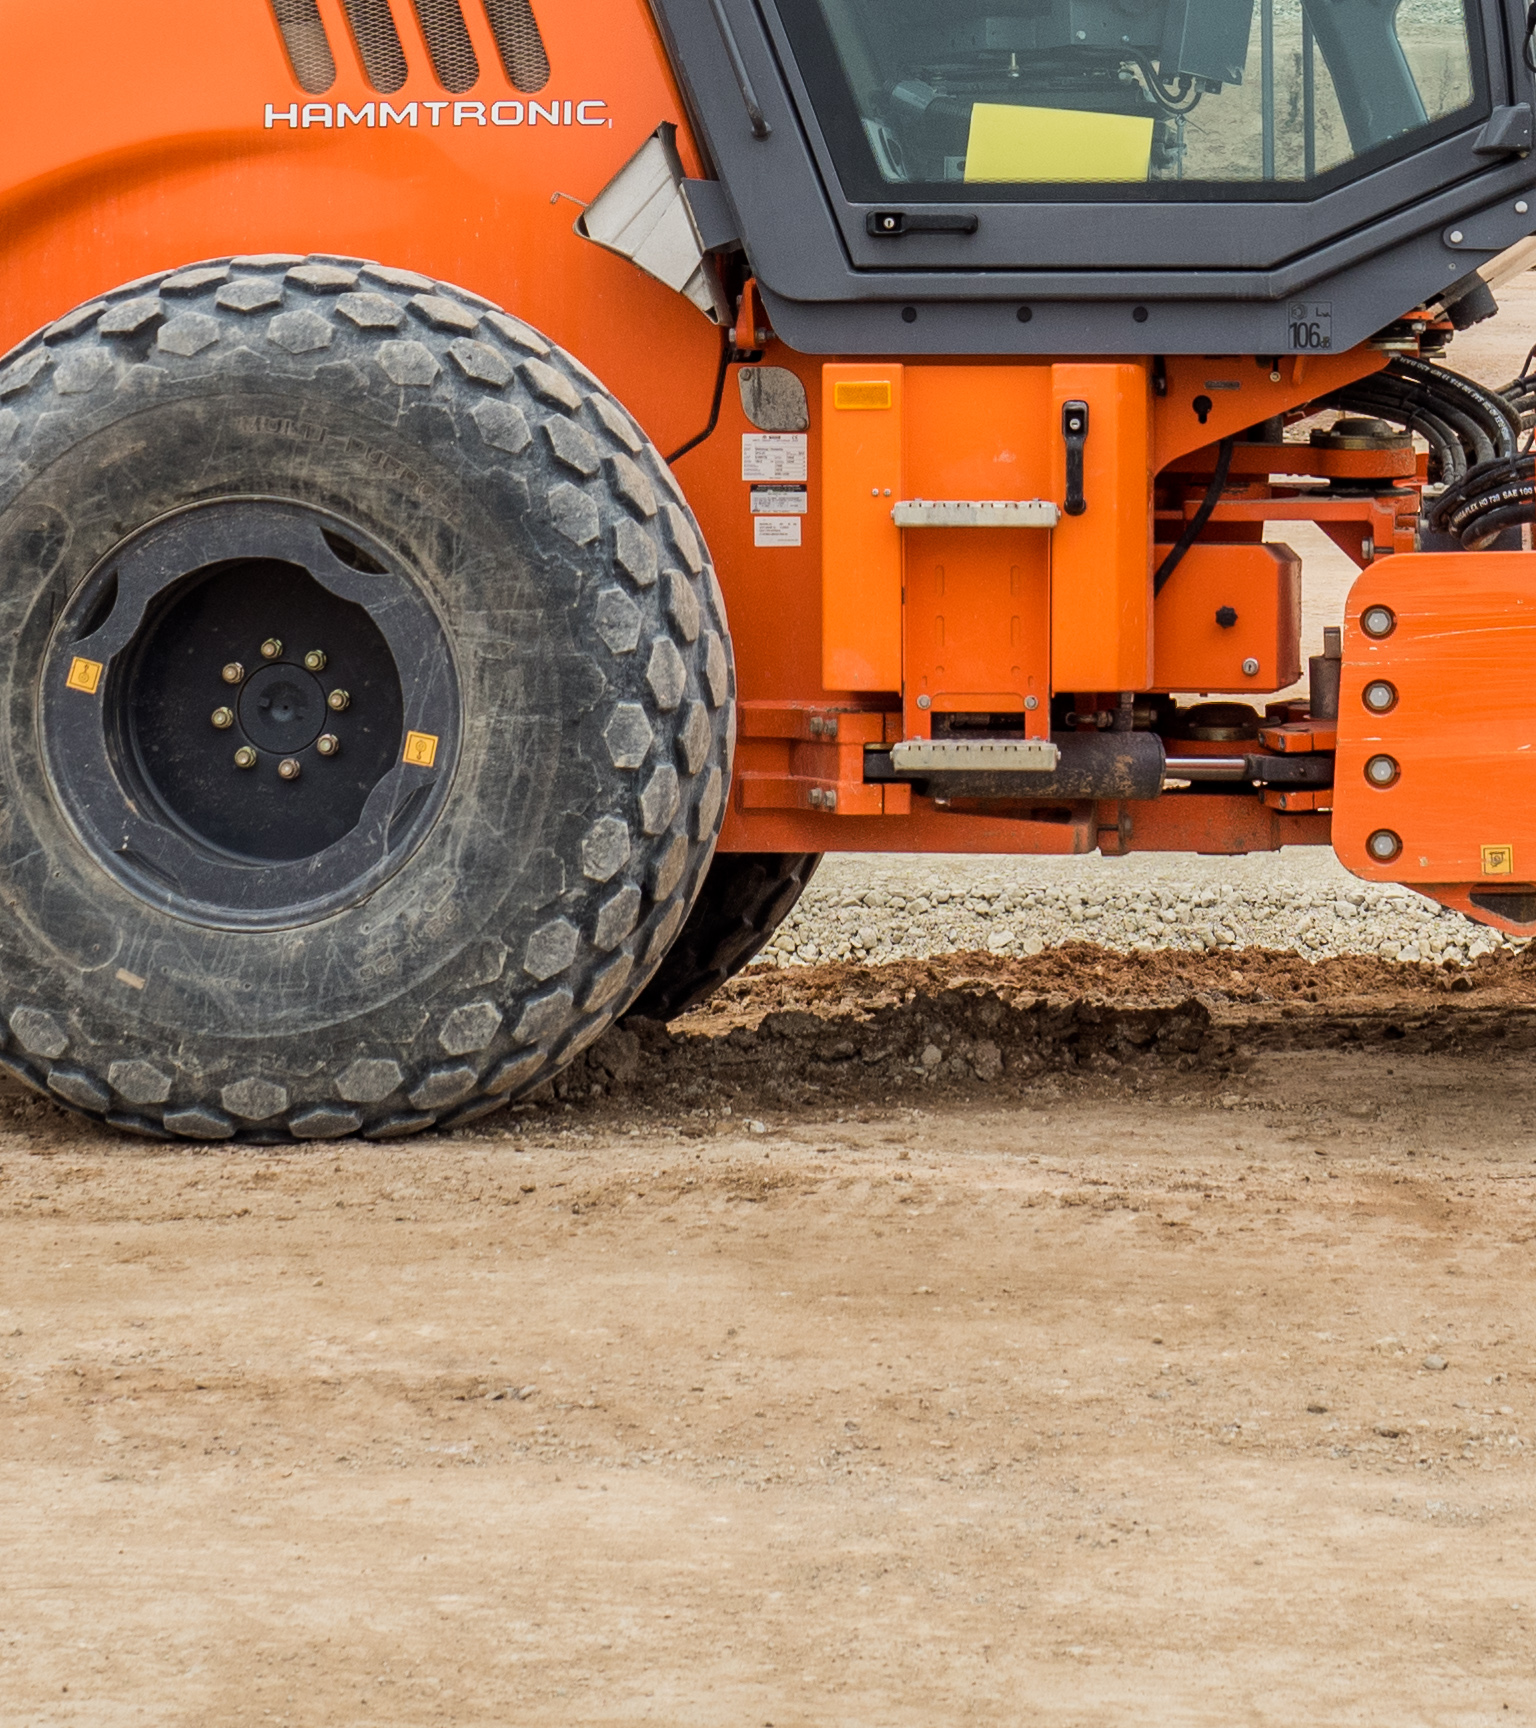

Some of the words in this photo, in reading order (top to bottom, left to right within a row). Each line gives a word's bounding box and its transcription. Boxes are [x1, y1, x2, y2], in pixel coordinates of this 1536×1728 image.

[264, 100, 609, 129] HAMMTRONIC
[1289, 322, 1321, 348] 106
[1502, 488, 1518, 500] SAE
